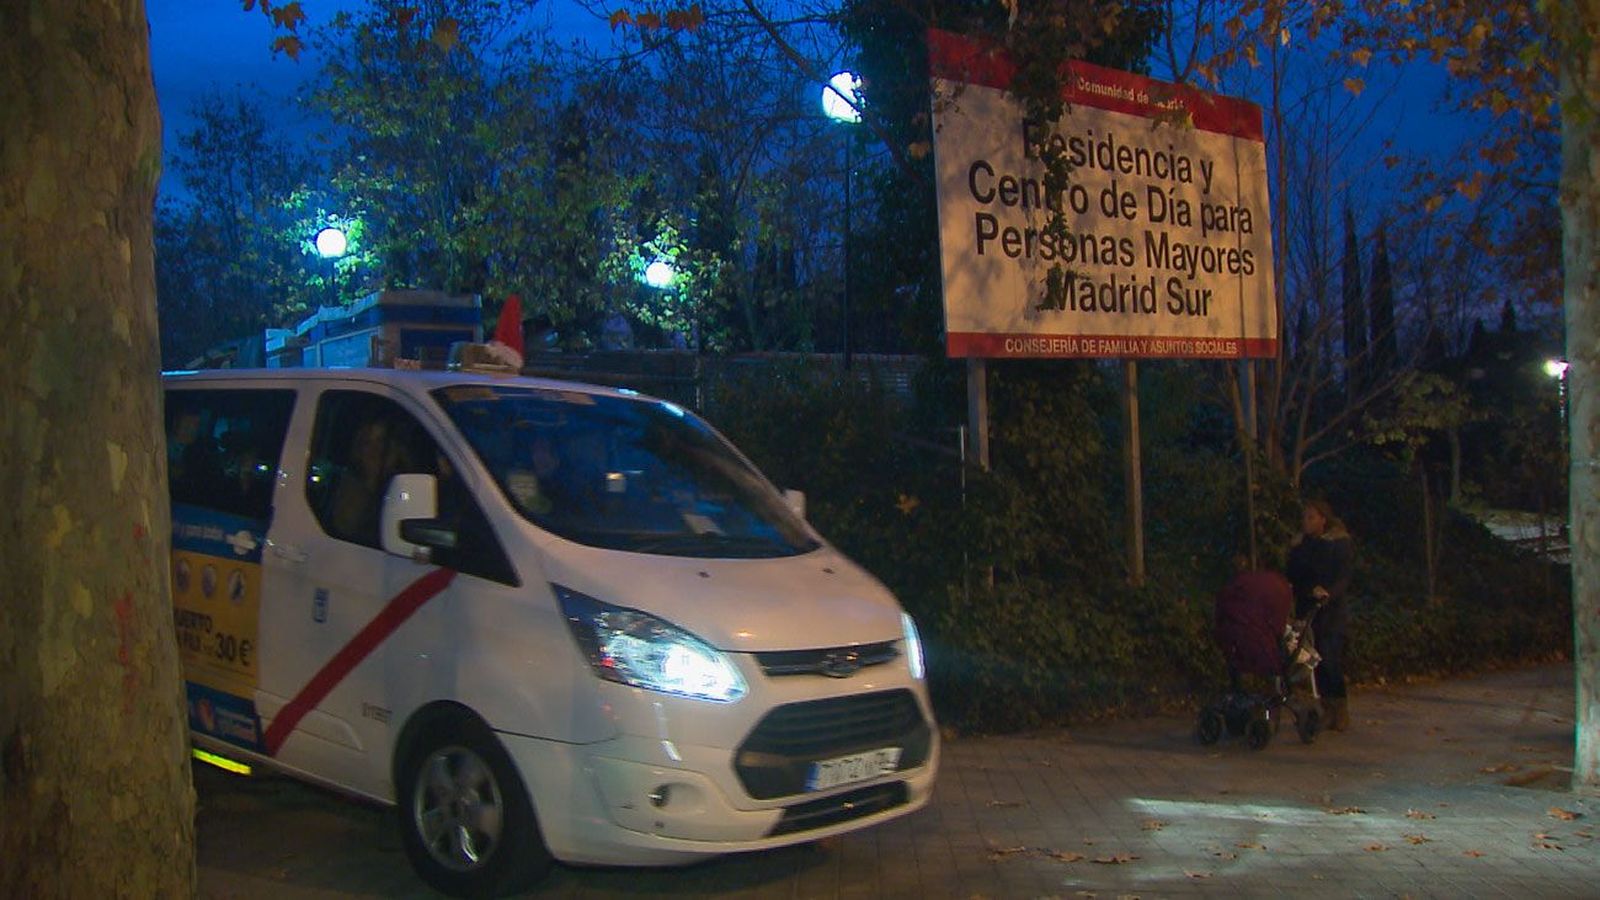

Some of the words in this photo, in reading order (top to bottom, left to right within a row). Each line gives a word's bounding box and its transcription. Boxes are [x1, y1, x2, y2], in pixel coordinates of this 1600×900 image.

[1077, 76, 1135, 102] Comunidad
[1136, 90, 1149, 105] de
[1200, 158, 1214, 195] y
[1100, 180, 1137, 221] de
[1146, 185, 1192, 228] Día
[1200, 202, 1253, 238] para
[975, 211, 1136, 268] Personas
[1145, 230, 1255, 280] Mayores
[1166, 276, 1212, 317] Sur
[1005, 336, 1079, 355] CONSEJERÍA
[1081, 339, 1097, 355] DE
[1098, 340, 1140, 355] FAMILIA
[1140, 340, 1149, 355] Y
[1150, 340, 1194, 355] ASUNTOS
[1195, 340, 1237, 355] SOCIALES
